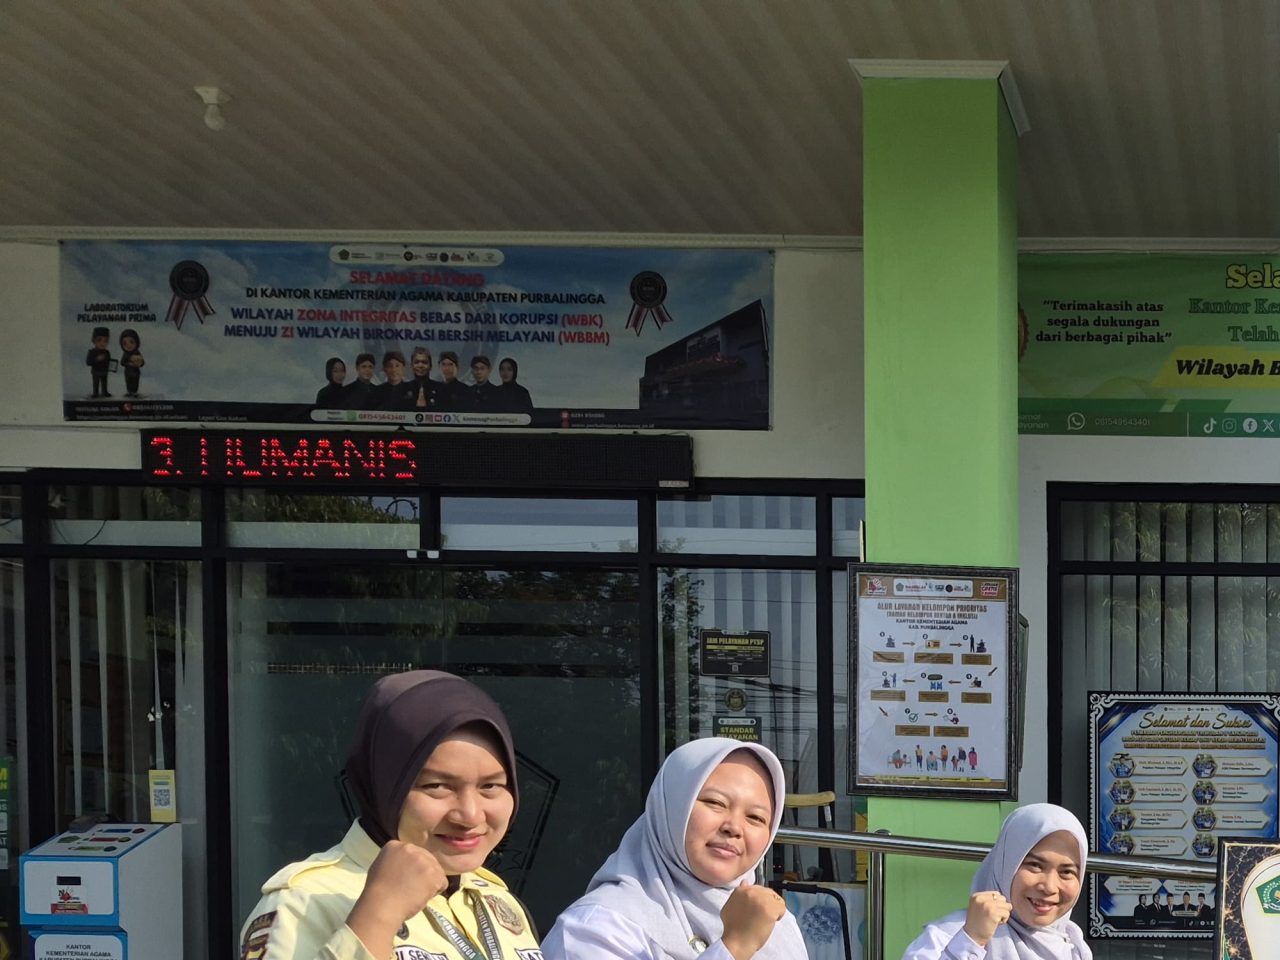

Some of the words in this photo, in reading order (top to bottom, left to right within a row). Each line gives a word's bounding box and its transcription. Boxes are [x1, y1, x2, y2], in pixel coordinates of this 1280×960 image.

[350, 271, 417, 285] SELAMAT
[246, 287, 258, 298] DI
[261, 287, 311, 299] KANTOR
[314, 288, 396, 301] KEMENTERIAN
[400, 289, 444, 301] AGAMA
[447, 291, 517, 304] KABUPATEN
[520, 292, 606, 304] PURBALINGGA
[1136, 301, 1164, 312] atas
[1188, 298, 1251, 314] Kantor
[231, 307, 293, 320] WILAYAH
[297, 308, 336, 321] ZONA
[340, 309, 417, 323] INTEGRITAS
[420, 311, 461, 324] BEBAS
[464, 312, 496, 325] DARI
[499, 312, 558, 326] KORUPSI
[561, 313, 603, 328] (WBK)
[1047, 316, 1089, 329] segala
[1093, 316, 1160, 329] dukungan
[224, 325, 278, 338] MENUJU
[281, 326, 294, 338] ZI
[297, 326, 360, 339] WILAYAH
[363, 327, 435, 341] BIROKRASI
[438, 329, 481, 342] BERSIH
[486, 330, 554, 343] MELAYANI
[558, 331, 610, 346] (WBBM)
[1035, 331, 1061, 342] dari
[1065, 331, 1123, 344] berbagai
[1228, 326, 1279, 341] Telah
[1176, 359, 1265, 379] Wilayah
[1138, 711, 1189, 729] Selamat
[1190, 714, 1211, 729] dan
[1212, 712, 1253, 730] Sukses
